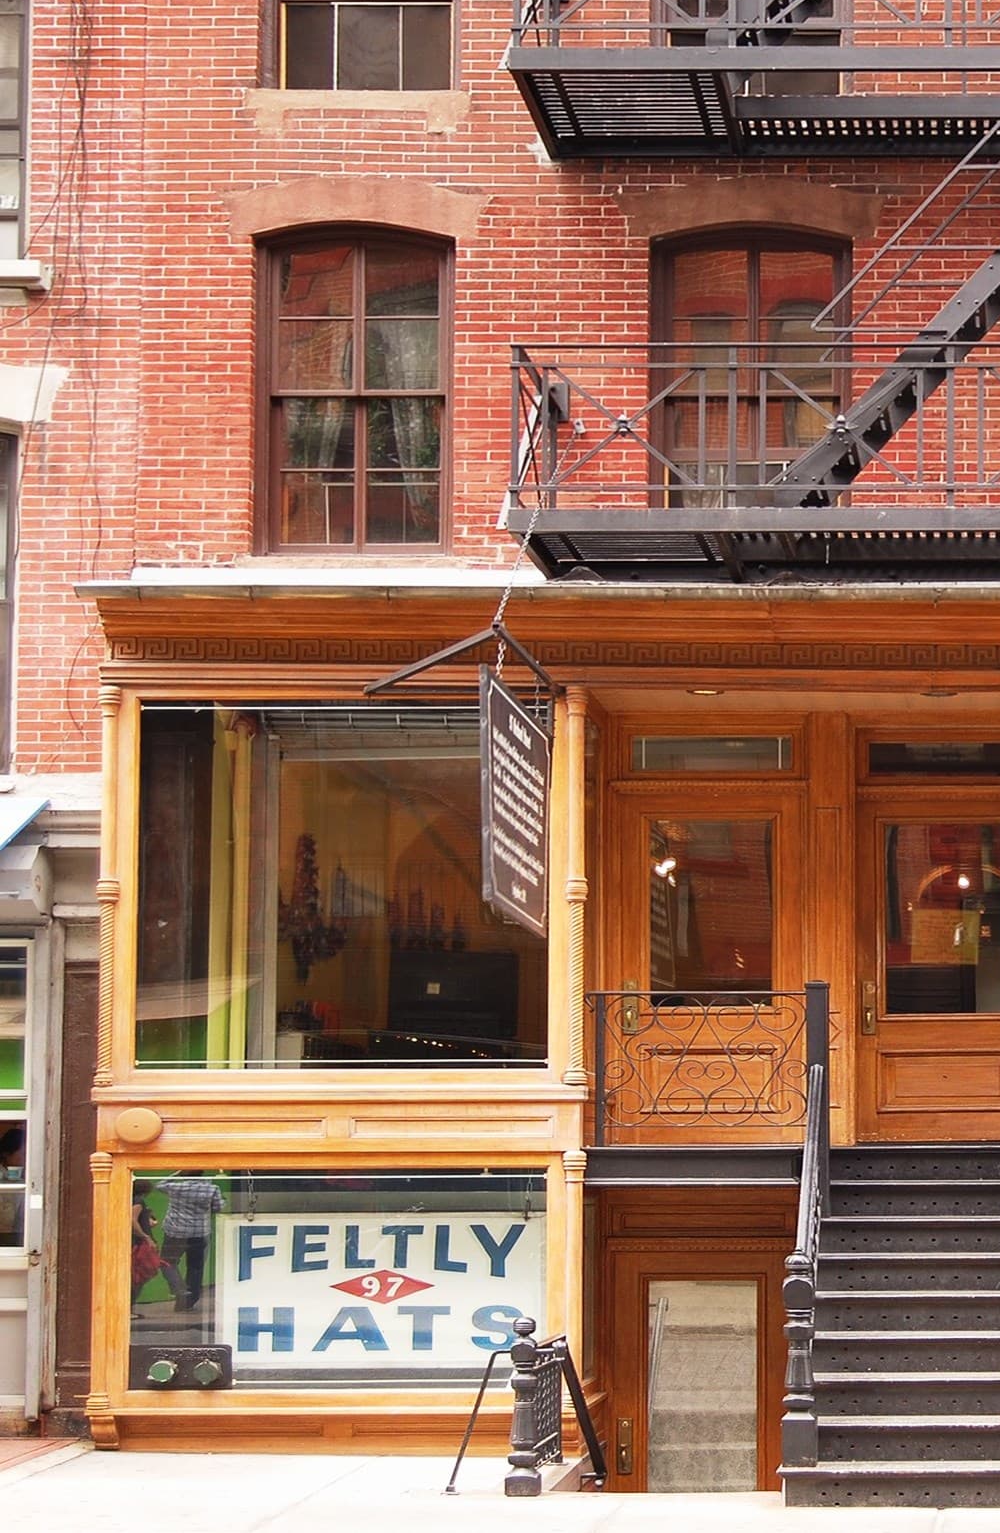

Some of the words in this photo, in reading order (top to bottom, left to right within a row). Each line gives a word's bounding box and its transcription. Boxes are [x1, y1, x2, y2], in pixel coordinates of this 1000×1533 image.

[238, 1224, 526, 1282] FELTLY
[361, 1276, 405, 1298] 97
[237, 1304, 524, 1352] HATS
